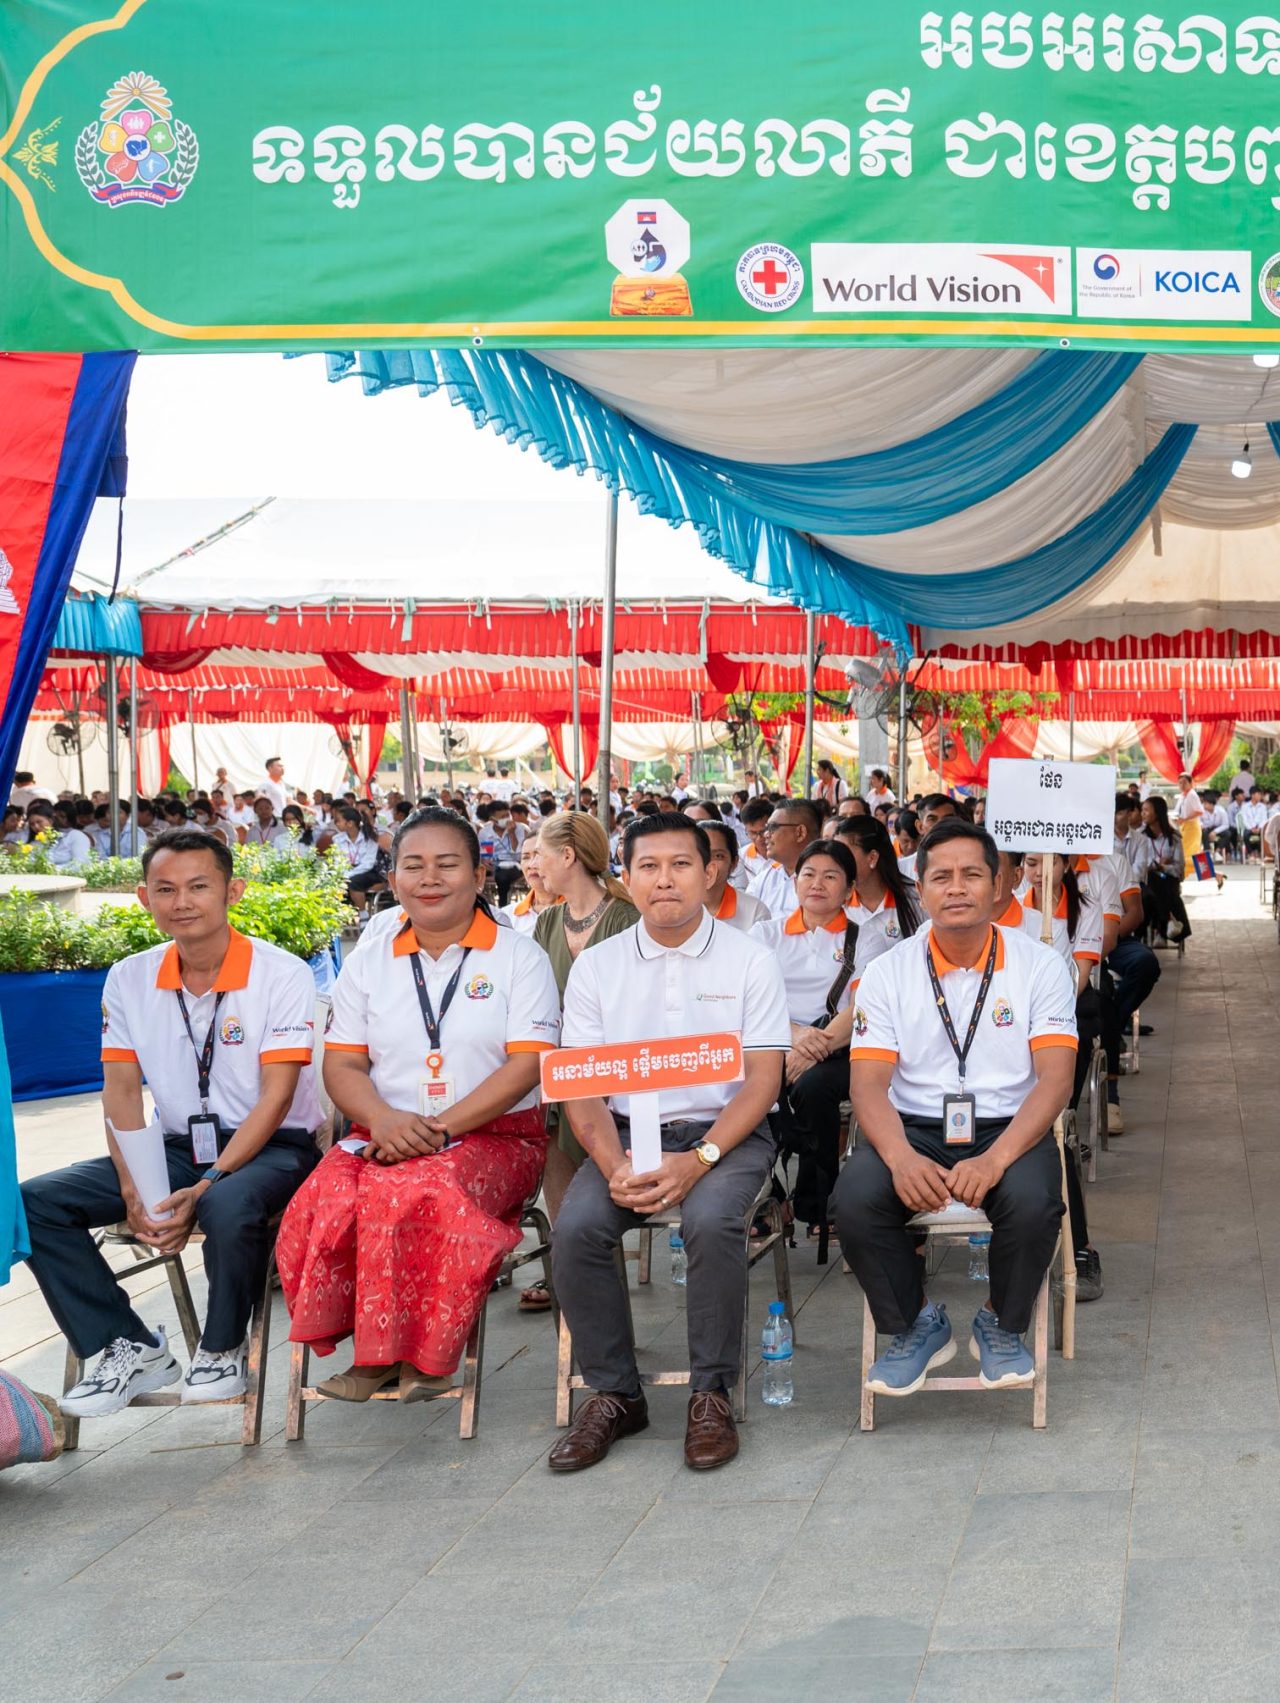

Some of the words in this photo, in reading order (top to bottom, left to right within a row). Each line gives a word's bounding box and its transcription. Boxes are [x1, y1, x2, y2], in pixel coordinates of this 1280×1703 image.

[740, 279, 773, 308] CAMBODIAN
[774, 298, 787, 308] RED
[787, 280, 800, 301] CROSS
[823, 274, 916, 302] World
[927, 275, 1021, 302] Vision
[1155, 271, 1240, 293] KOICA
